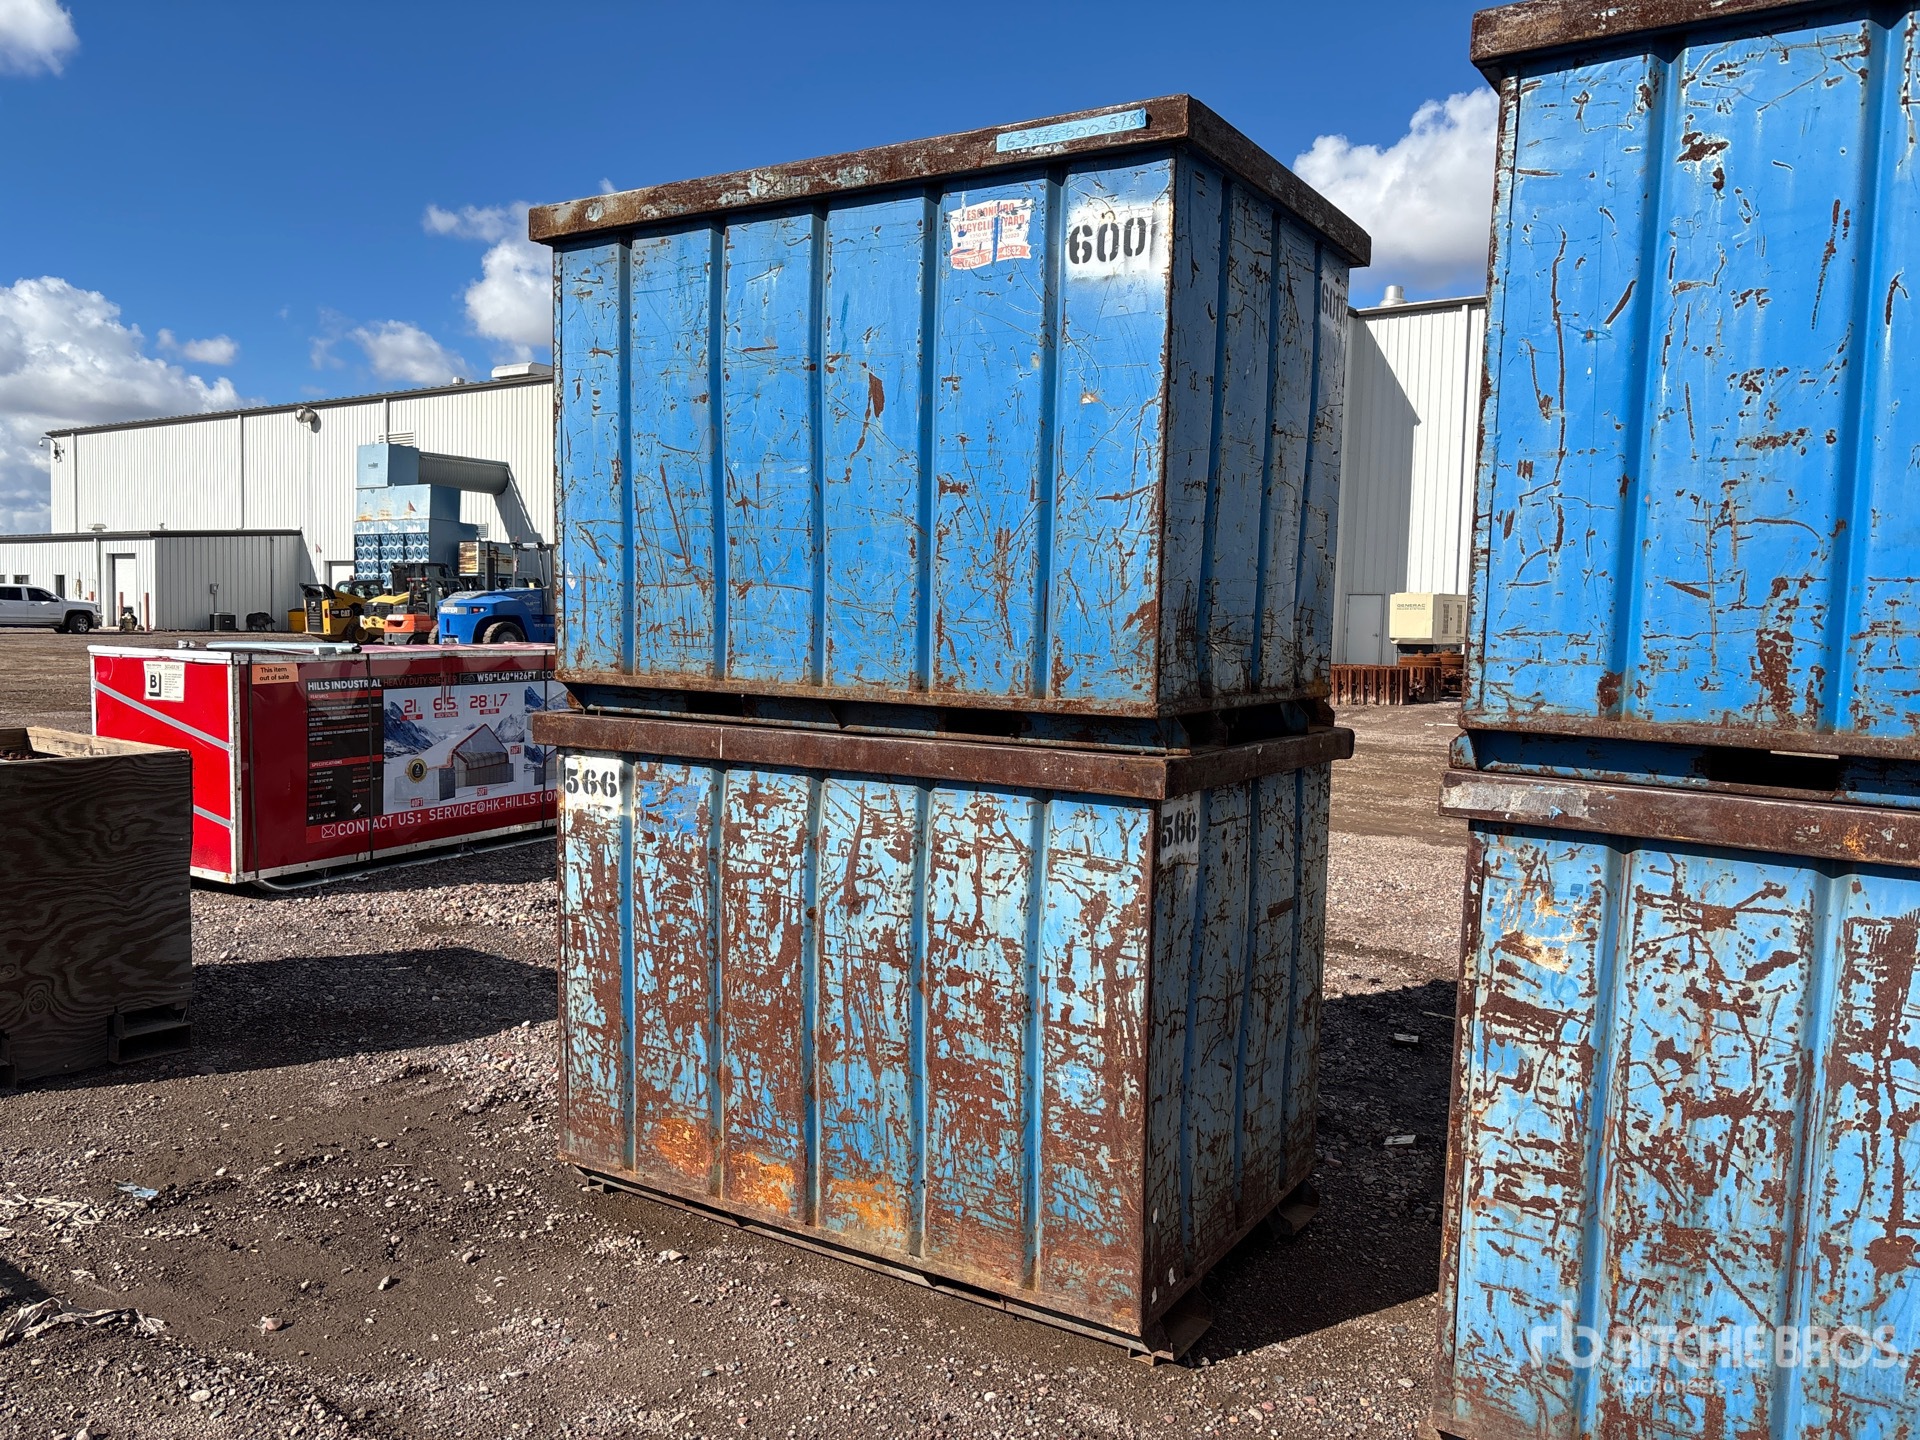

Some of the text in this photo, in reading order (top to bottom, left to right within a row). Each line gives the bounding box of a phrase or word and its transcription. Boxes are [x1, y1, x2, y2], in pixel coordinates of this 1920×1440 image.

[1069, 217, 1147, 265] 600
[340, 609, 351, 617] CAT
[150, 674, 158, 689] B
[308, 681, 333, 691] HILLS
[331, 679, 382, 690] INDUSTRAL
[383, 678, 408, 687] HEAVY
[409, 676, 428, 686] DUTY
[404, 699, 417, 713] 21
[566, 767, 618, 798] 566
[337, 815, 394, 836] CONTACT
